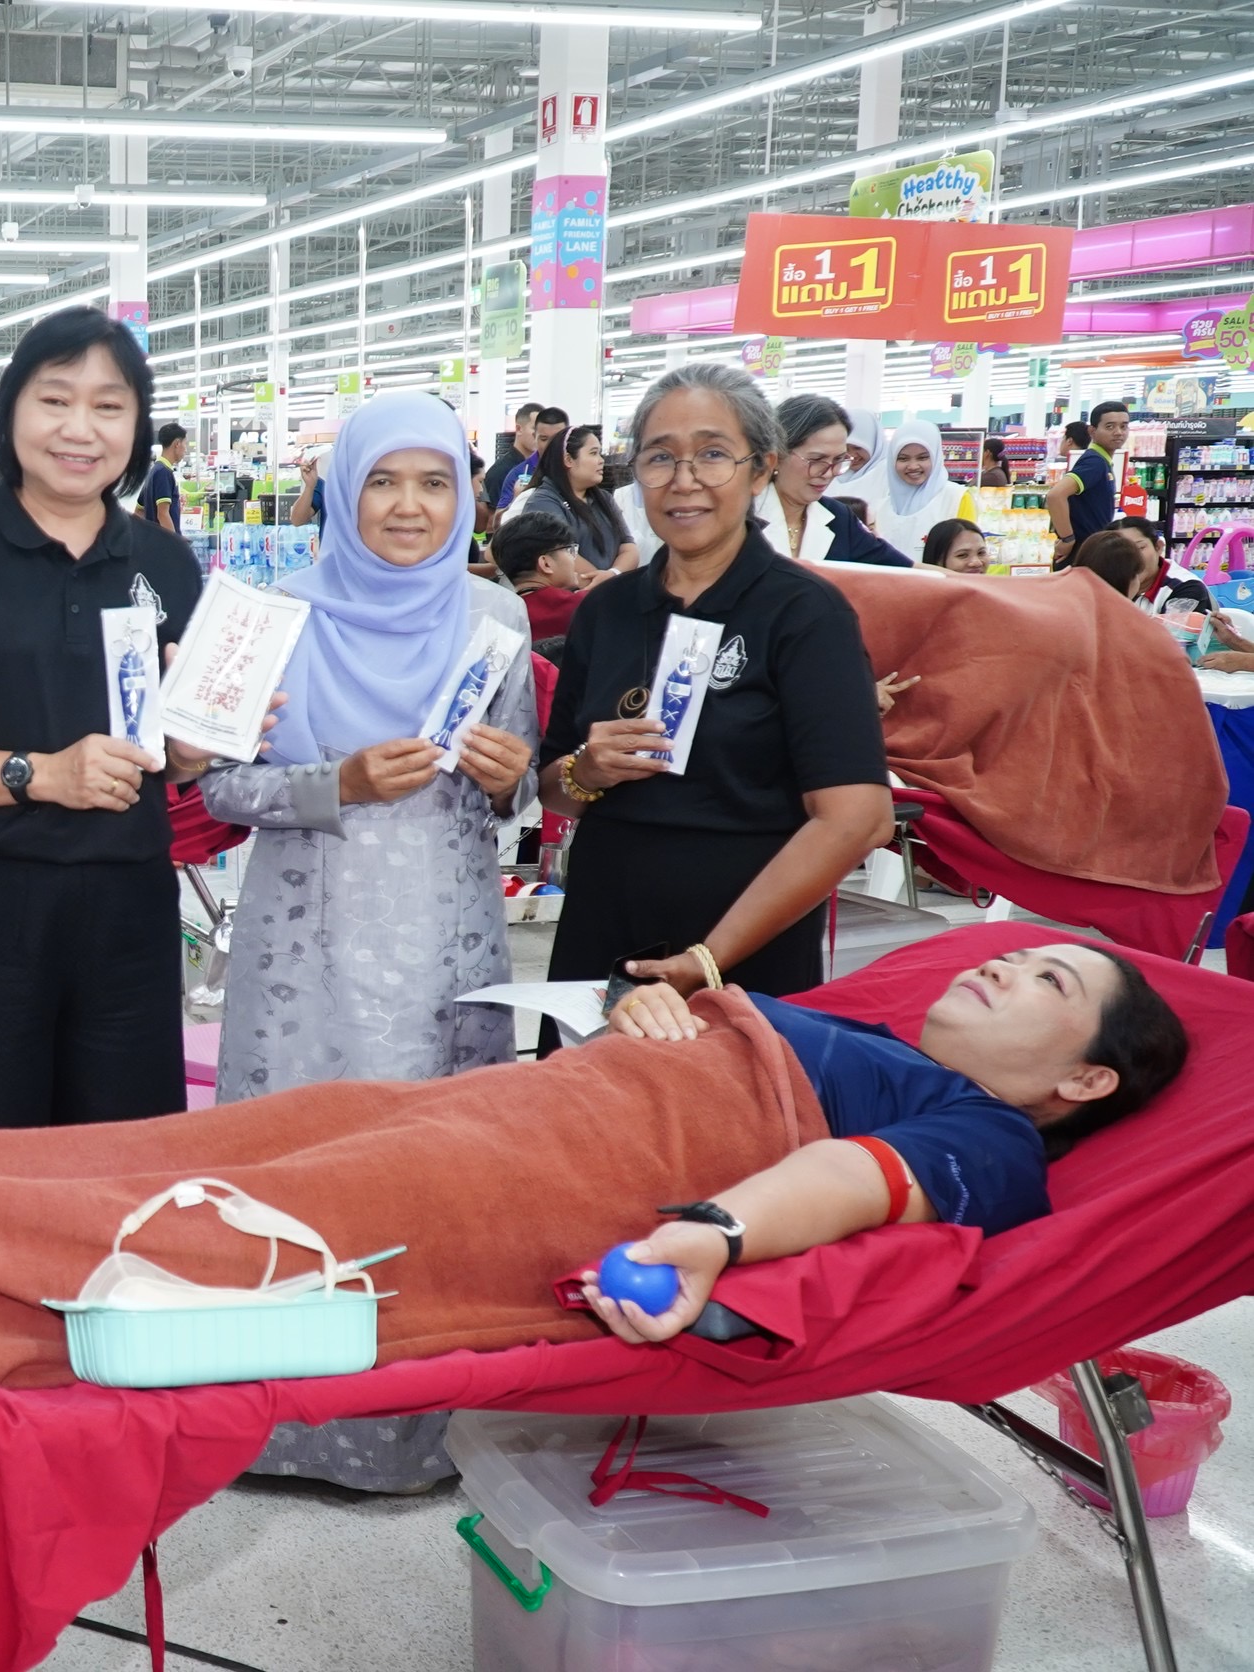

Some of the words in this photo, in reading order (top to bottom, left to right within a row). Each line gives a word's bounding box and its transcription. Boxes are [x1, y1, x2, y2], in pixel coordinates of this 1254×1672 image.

[903, 169, 975, 199] Healthy
[564, 218, 601, 227] FAMILY
[566, 241, 597, 252] LANE
[782, 263, 806, 282] ซื้อ
[814, 248, 836, 280] 1
[953, 270, 973, 288] ซื้อ
[980, 255, 997, 286] 1
[781, 281, 848, 304] แถม
[849, 247, 886, 299] 1
[952, 287, 1007, 310] แถม
[1008, 253, 1039, 304] 1
[824, 307, 839, 315] BUY
[863, 304, 879, 312] FREE
[506, 319, 517, 335] 10
[1191, 320, 1214, 329] สวย
[1193, 327, 1216, 337] ครบ
[1220, 330, 1247, 348] 50
[957, 343, 974, 351] SALE
[442, 360, 455, 377] 2
[764, 353, 781, 369] 50
[954, 355, 973, 370] 50
[342, 374, 351, 388] 3
[257, 385, 266, 397] 4
